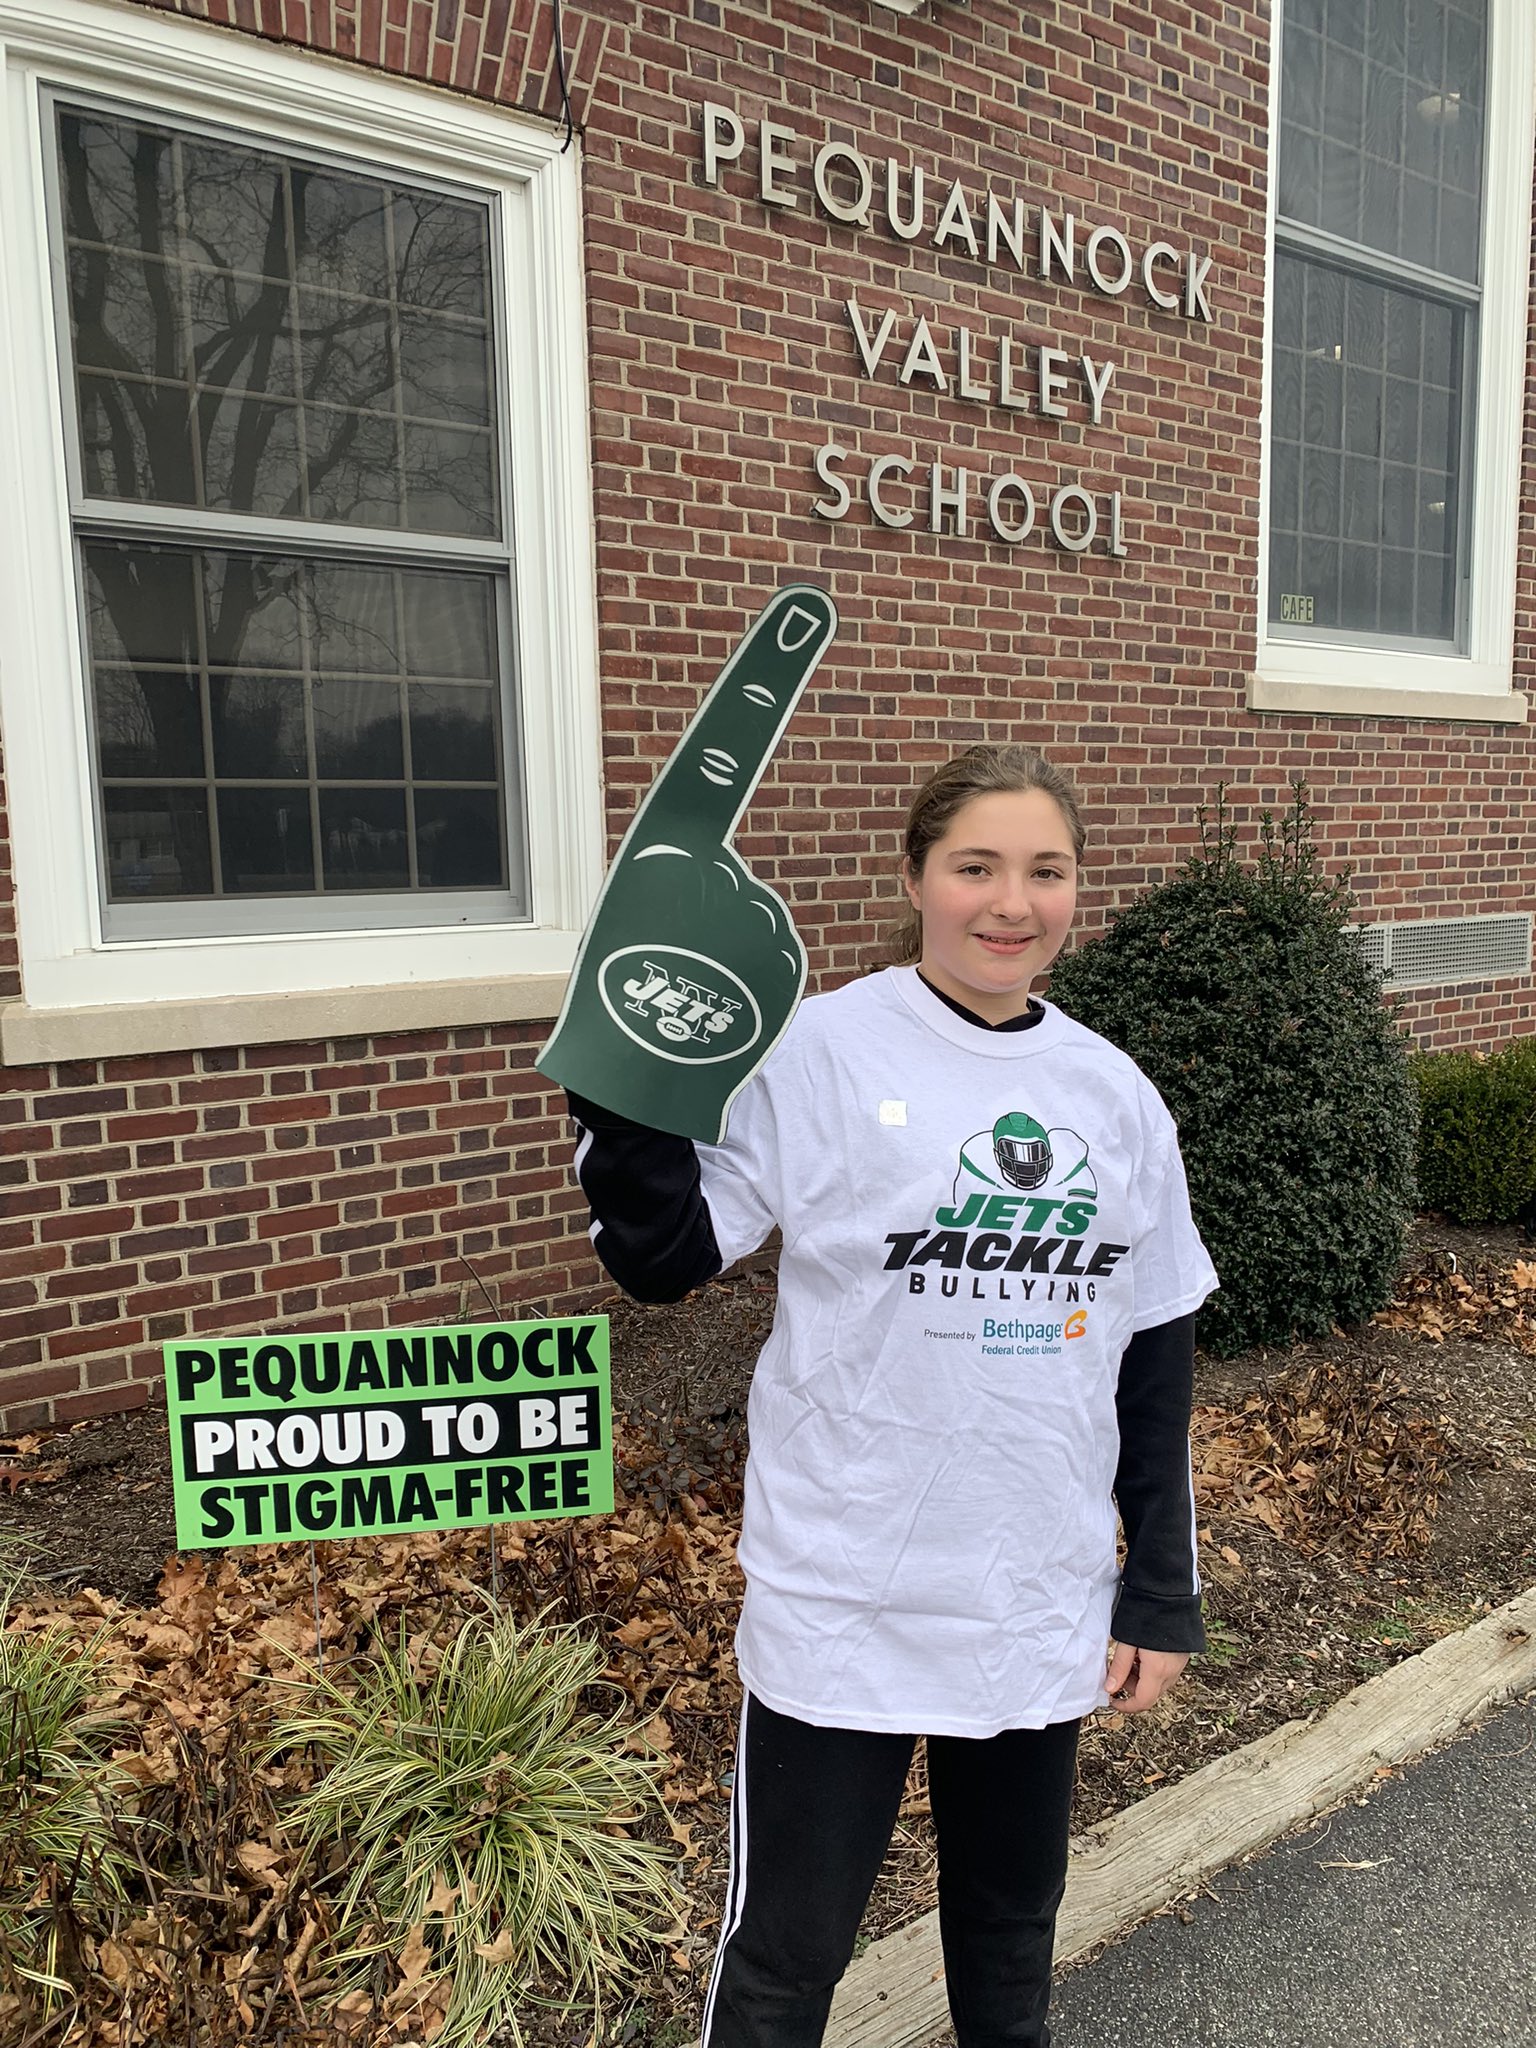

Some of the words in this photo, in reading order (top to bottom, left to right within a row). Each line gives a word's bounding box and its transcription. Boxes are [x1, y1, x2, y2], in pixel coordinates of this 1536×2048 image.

[703, 100, 1214, 322] PEQUANNOCK
[845, 299, 1116, 424] VALLEY
[813, 443, 1128, 557] SCHOOL
[1281, 595, 1313, 621] CAFE
[623, 976, 735, 1034] JETS
[935, 1193, 1098, 1236] JETS
[883, 1229, 1130, 1277] TACKLE
[909, 1272, 1096, 1303] BULLYING
[924, 1329, 966, 1340] Presented
[967, 1331, 976, 1342] by
[983, 1318, 1062, 1342] Bethpage
[981, 1344, 1014, 1355] Federal
[1016, 1345, 1039, 1355] Credit
[1041, 1345, 1062, 1355] Union
[175, 1325, 598, 1402] PEQUANNOCK
[194, 1409, 406, 1474] PROUD
[421, 1402, 500, 1457] TO
[519, 1394, 589, 1449] BE
[200, 1458, 590, 1539] STIGMA-FREE
